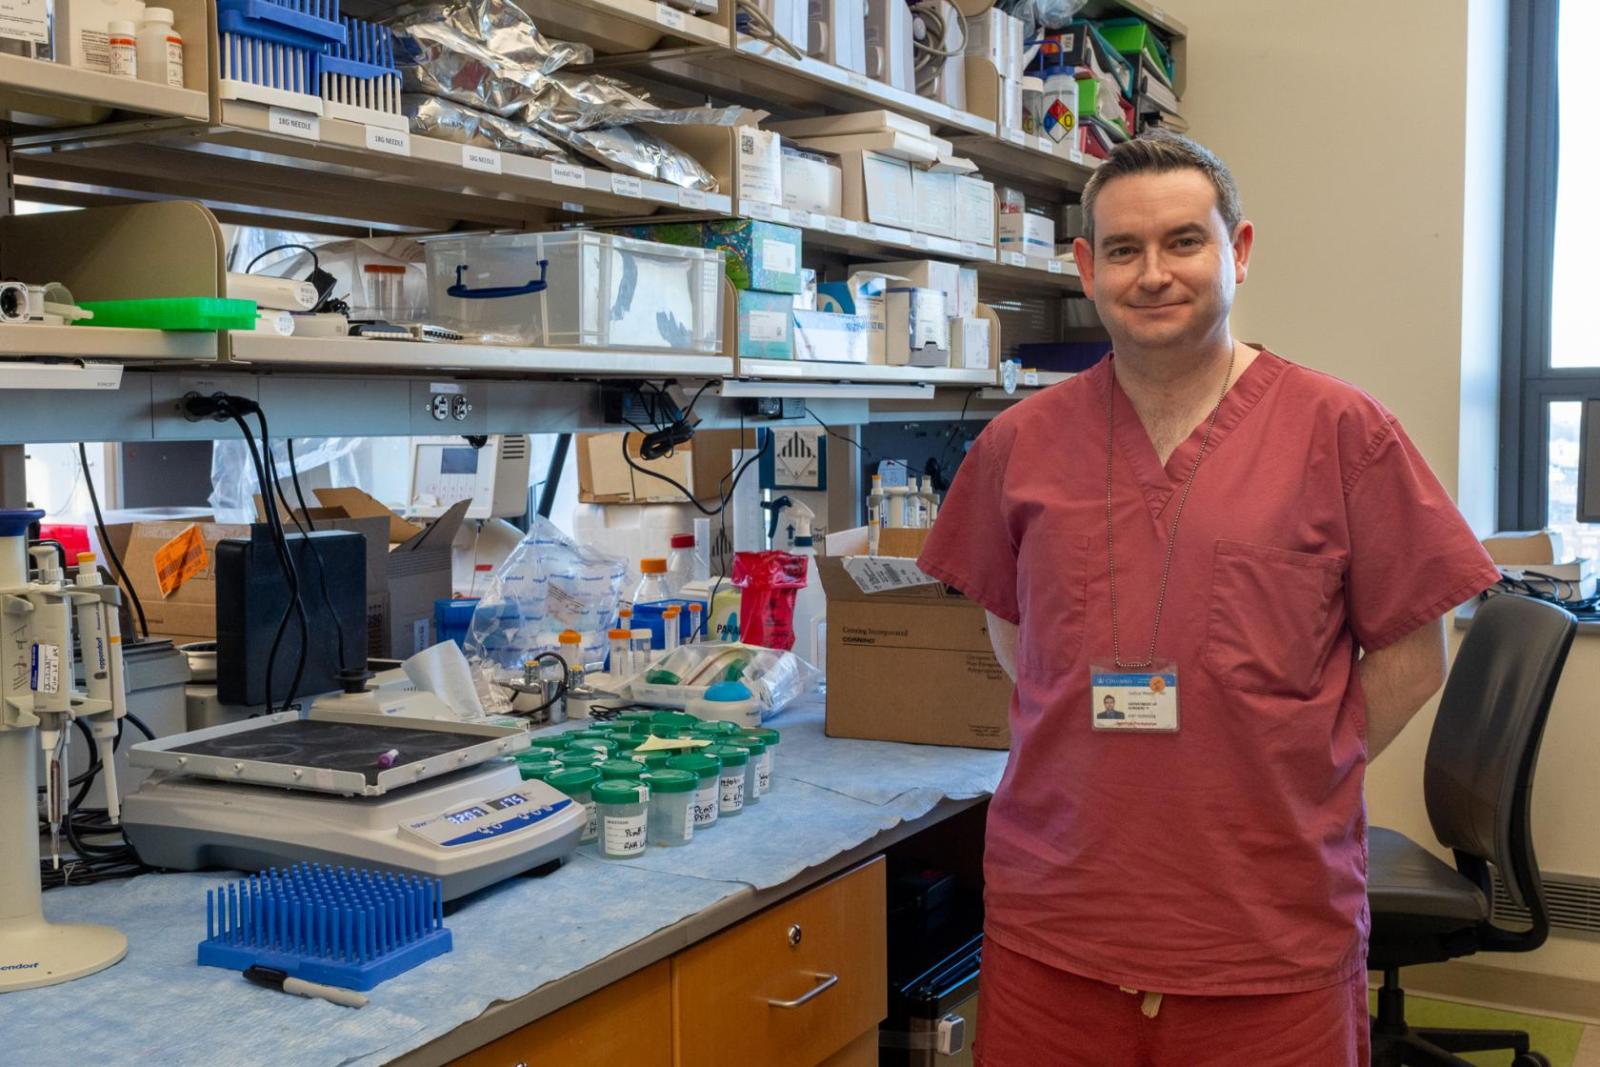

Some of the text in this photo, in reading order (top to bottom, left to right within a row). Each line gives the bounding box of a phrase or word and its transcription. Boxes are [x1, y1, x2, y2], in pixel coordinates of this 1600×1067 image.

[278, 117, 311, 130] 18G NEEDLE
[375, 135, 404, 147] 18G NEEDLE
[478, 156, 495, 166] NEEDLE
[842, 626, 908, 637] Corning Incorporated
[96, 637, 106, 670] eppendorf
[500, 794, 524, 808] 175
